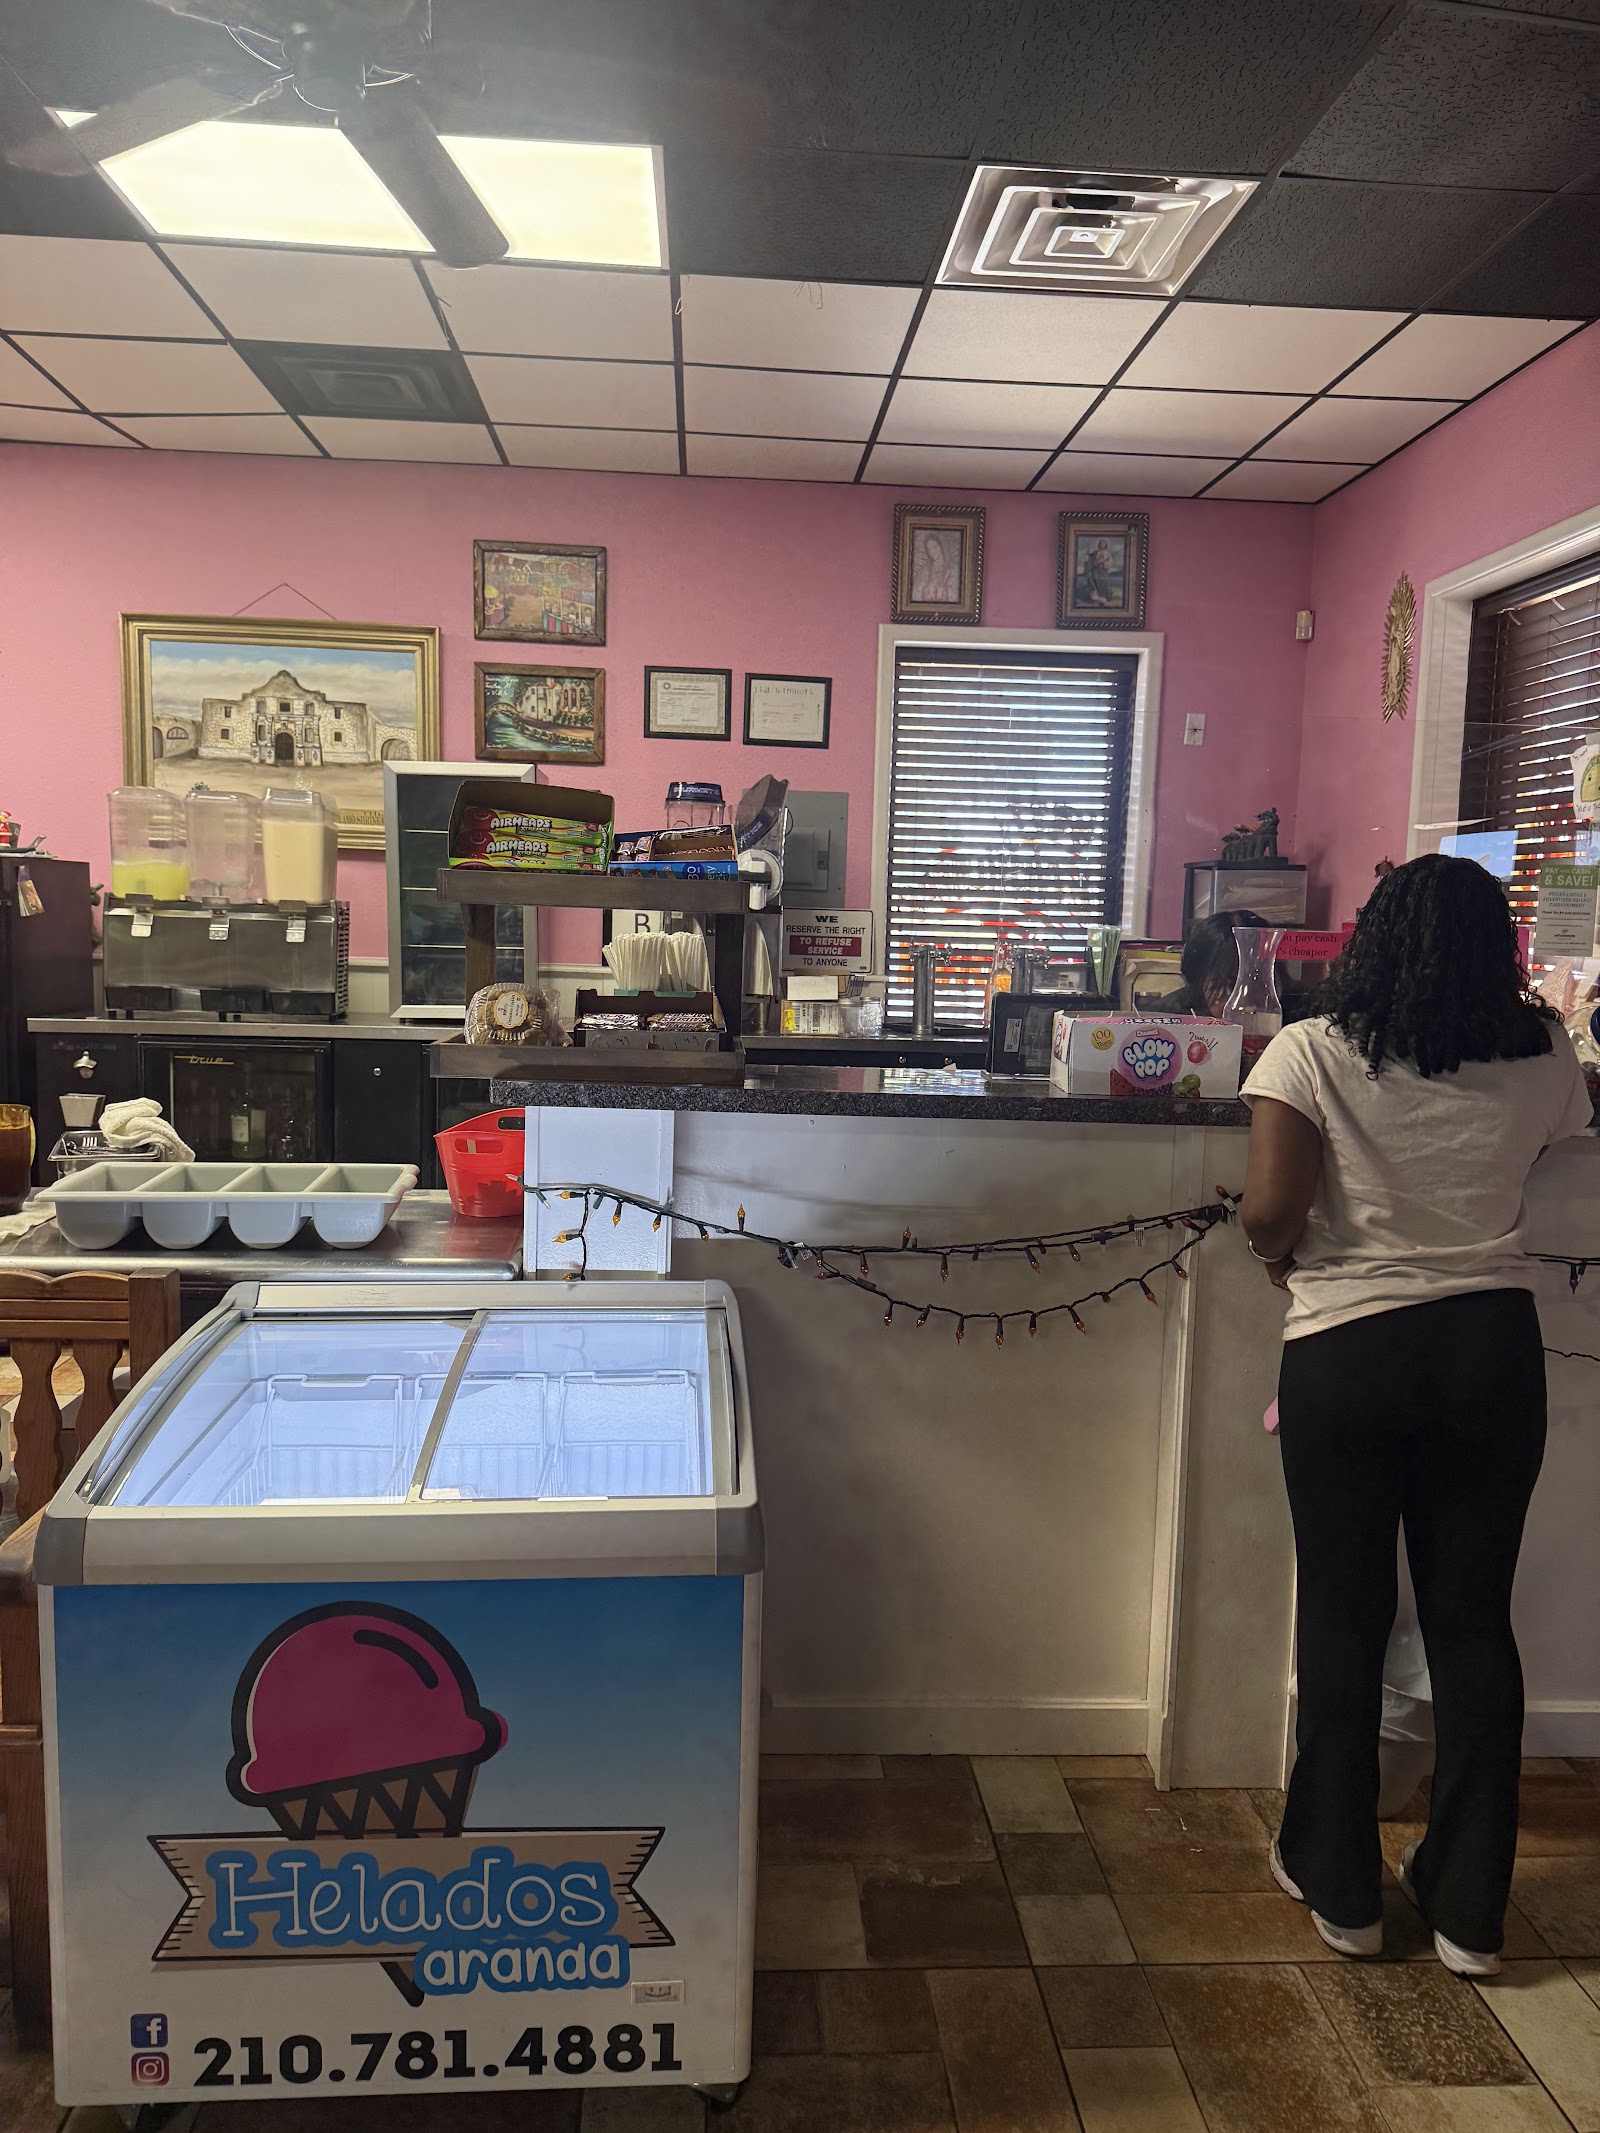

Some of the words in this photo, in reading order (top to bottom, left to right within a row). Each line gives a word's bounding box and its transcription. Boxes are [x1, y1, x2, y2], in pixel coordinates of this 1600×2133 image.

[490, 816, 553, 830] AIRHEADS
[486, 840, 549, 854] AIRHEADS
[1545, 874, 1553, 885] &
[1557, 874, 1593, 887] SAVE!
[815, 915, 838, 923] WE
[786, 925, 822, 934] RESERVE
[825, 926, 840, 934] THE
[842, 927, 866, 935] RIGHT
[800, 936, 812, 945] TO
[815, 937, 852, 946] REFUSE
[1295, 935, 1313, 944] pay
[1314, 934, 1337, 943] cash
[807, 946, 843, 955] SERVICE
[1288, 947, 1328, 957] cheaper
[803, 958, 814, 966] TO
[816, 958, 848, 967] ANYONE
[1092, 1029, 1111, 1042] 100
[1189, 1031, 1195, 1042] 2
[1122, 1038, 1175, 1066] BLOW
[1133, 1058, 1171, 1079] POP
[218, 1858, 607, 1938] Helados
[422, 1942, 622, 1987] aranda
[193, 2022, 683, 2087] 210.781.4881
